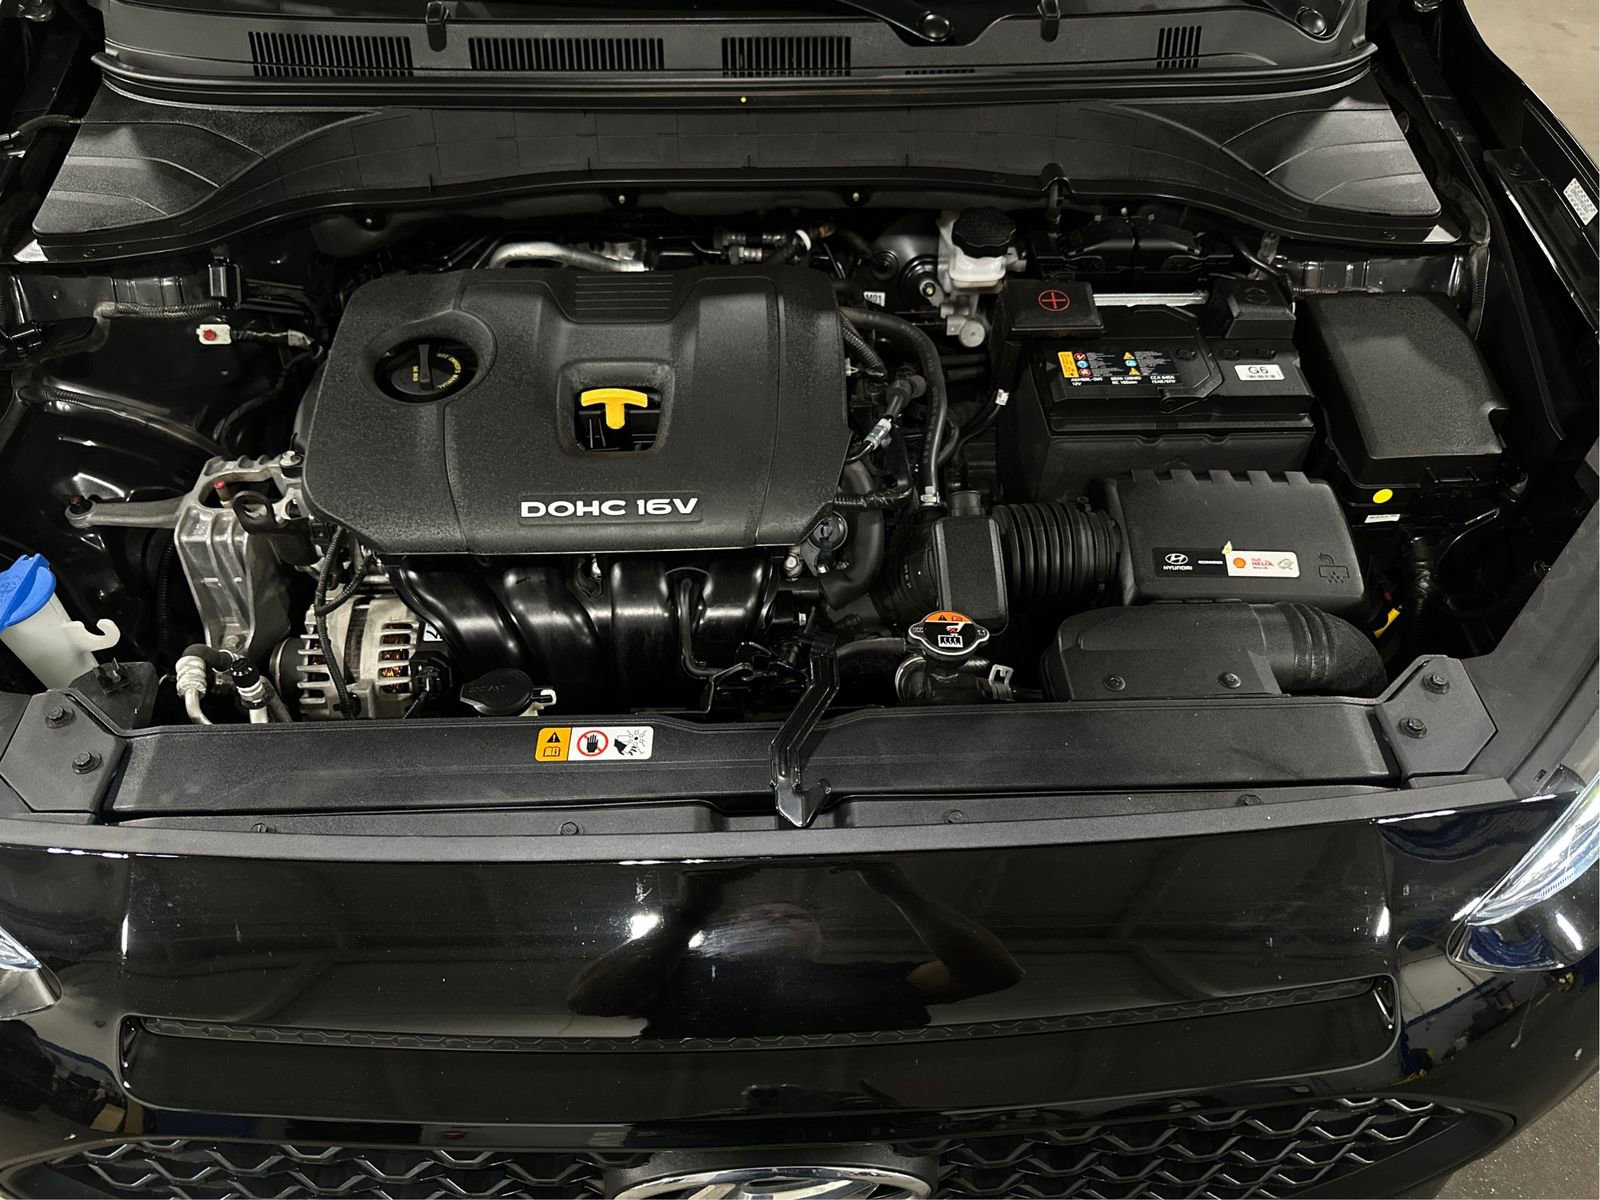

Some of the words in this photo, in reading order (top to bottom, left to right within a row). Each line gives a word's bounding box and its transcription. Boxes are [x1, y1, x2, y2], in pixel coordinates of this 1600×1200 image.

[1247, 366, 1269, 375] G6
[437, 374, 458, 390] MANUAL
[520, 499, 627, 518] DOHC
[636, 497, 699, 516] 16V
